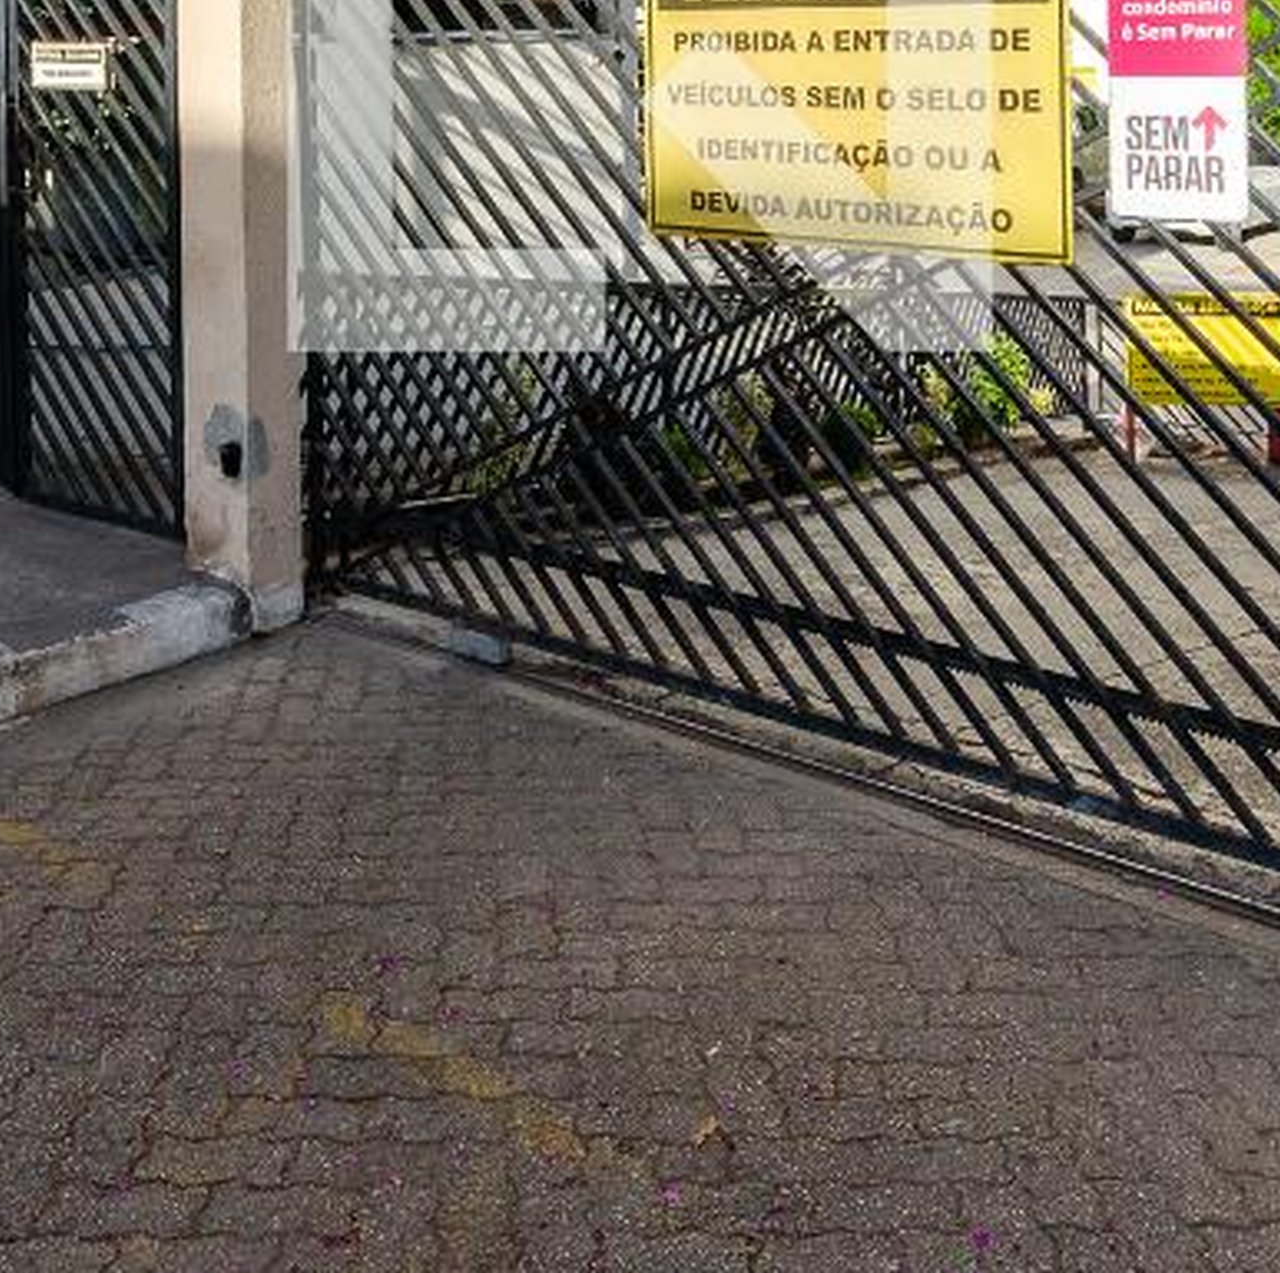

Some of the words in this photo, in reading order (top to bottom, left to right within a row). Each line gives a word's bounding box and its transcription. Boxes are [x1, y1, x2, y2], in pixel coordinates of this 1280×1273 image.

[673, 31, 797, 53] PROIBIDA
[806, 30, 825, 53] A
[833, 29, 976, 54] ENTRADA
[989, 28, 1031, 53] DE
[1136, 23, 1177, 41] Sem
[1180, 23, 1236, 41] Parar
[667, 81, 797, 108] VEÍCULOS
[805, 85, 866, 110] SEM
[875, 87, 896, 112] O
[906, 87, 987, 112] SELO
[998, 88, 1043, 113] DE
[1124, 115, 1190, 152] SEM
[697, 137, 914, 173] IDENTIFICAÇÃO
[924, 144, 969, 171] OU
[981, 147, 1003, 173] A
[1125, 153, 1226, 194] PARAR
[689, 190, 790, 219] DEVIDA
[793, 196, 1013, 237] AUTORIZAÇÃO
